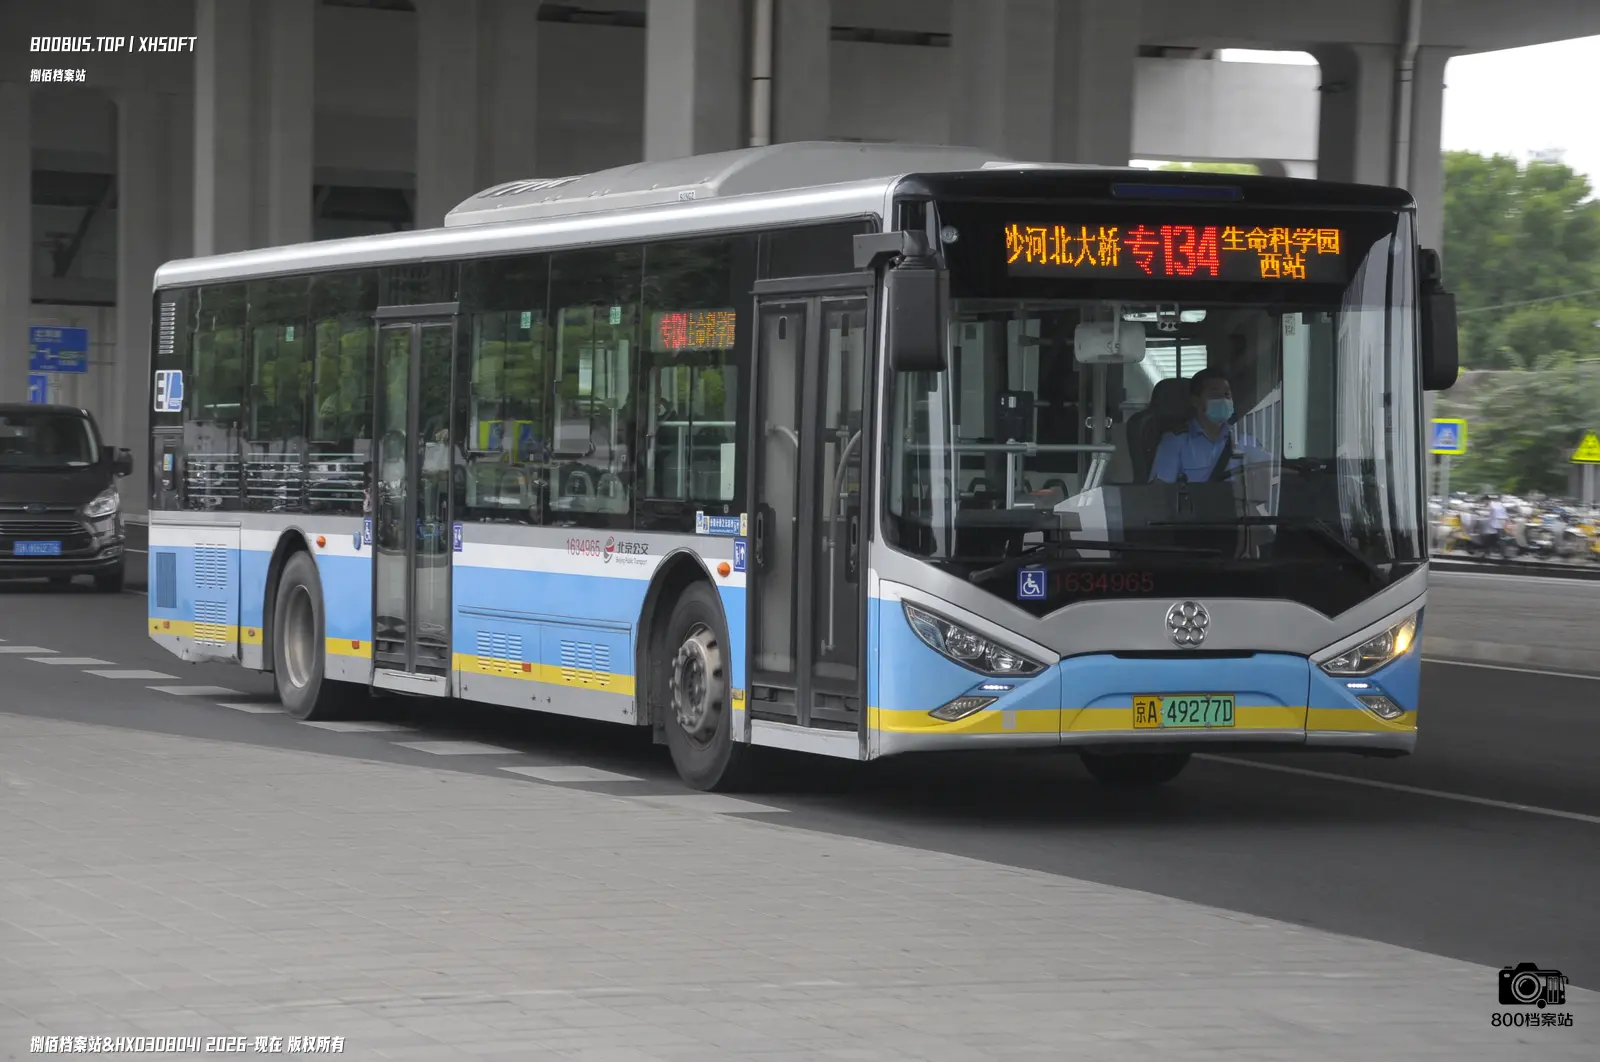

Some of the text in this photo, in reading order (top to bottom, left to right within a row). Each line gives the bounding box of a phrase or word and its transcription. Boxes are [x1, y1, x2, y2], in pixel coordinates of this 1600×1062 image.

[1005, 224, 1121, 266] 沙河北大桥
[1221, 226, 1340, 255] 生命科学园
[1258, 252, 1306, 279] 西站
[567, 538, 600, 557] 1634965
[617, 541, 649, 555] 北京公交
[1054, 572, 1155, 593] 1634965
